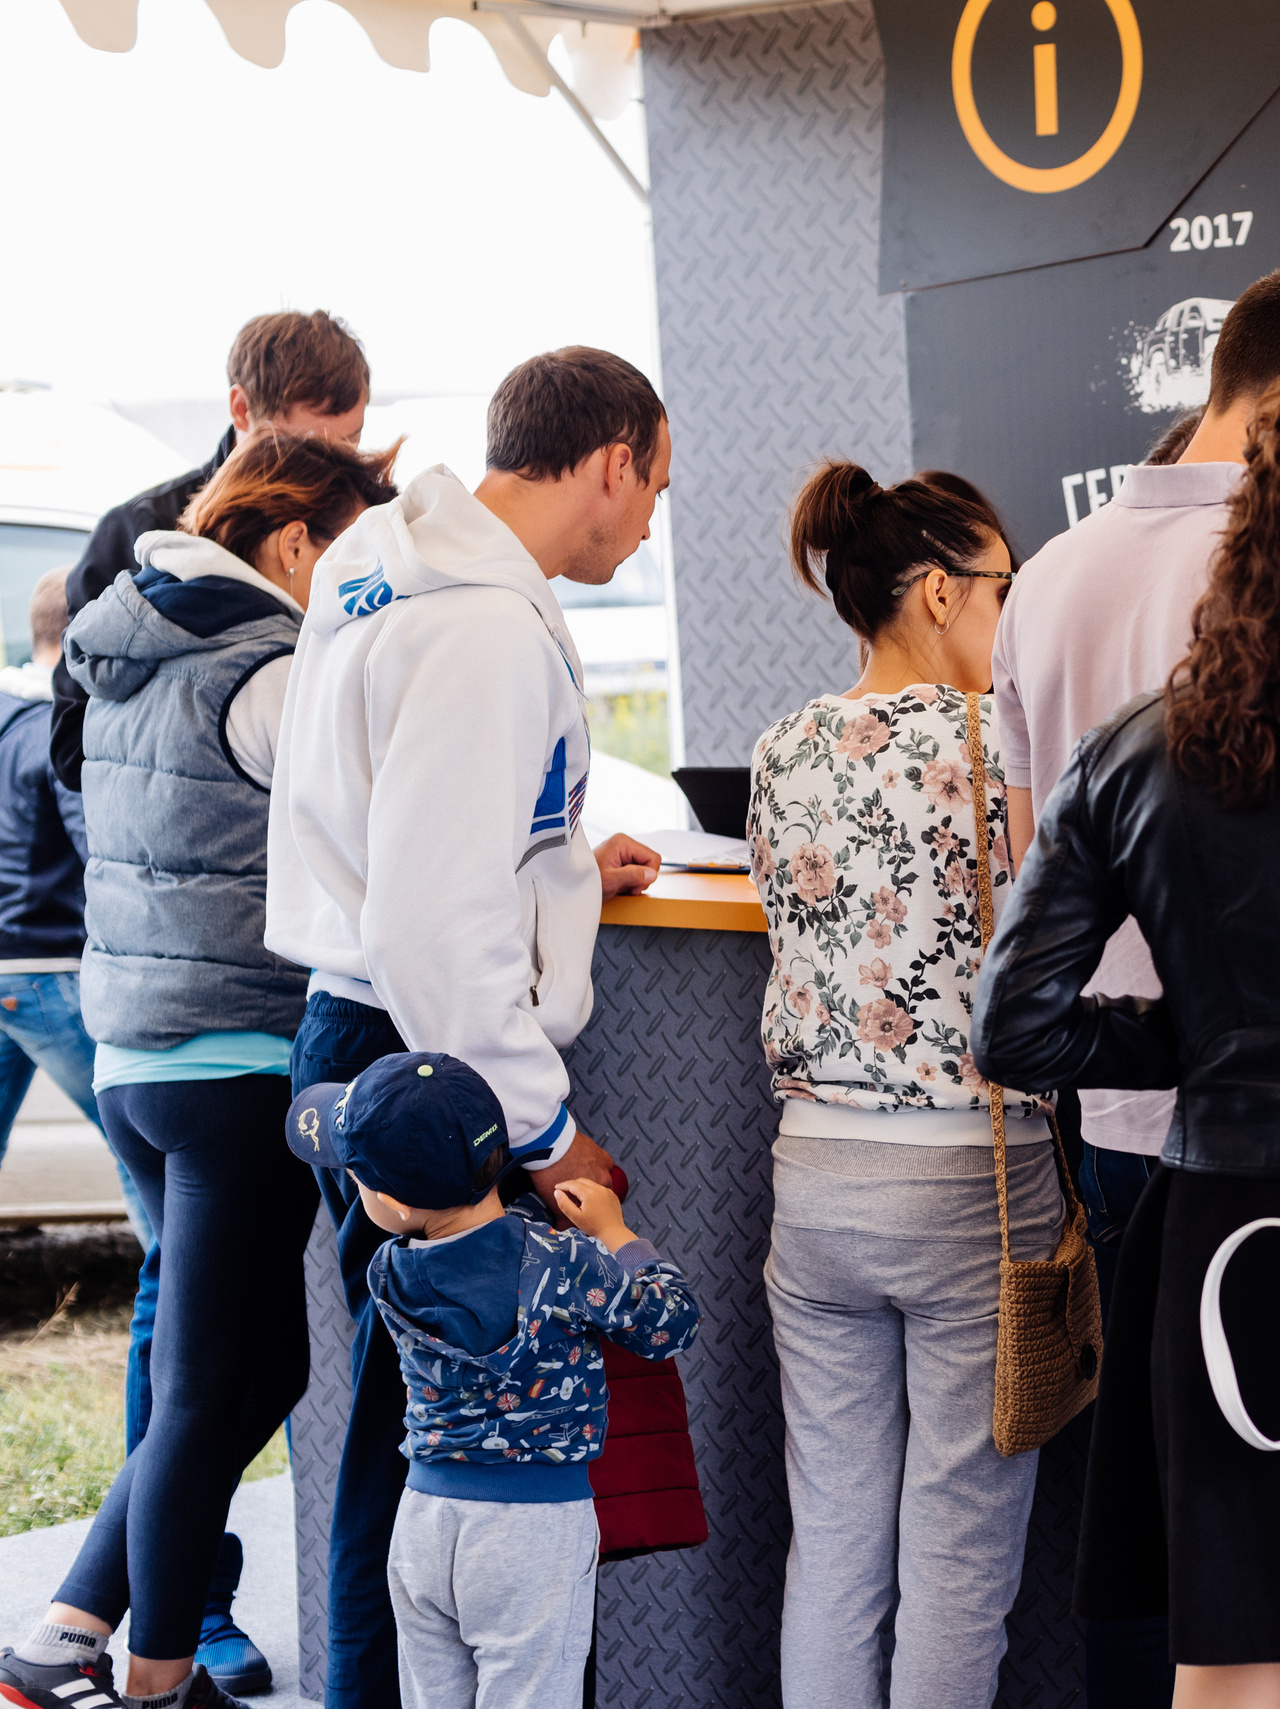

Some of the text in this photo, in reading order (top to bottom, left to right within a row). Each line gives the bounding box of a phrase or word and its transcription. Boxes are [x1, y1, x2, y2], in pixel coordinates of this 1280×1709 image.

[1169, 210, 1254, 253] 2017
[60, 1631, 97, 1648] PUMA
[142, 1692, 178, 1709] PUMA
